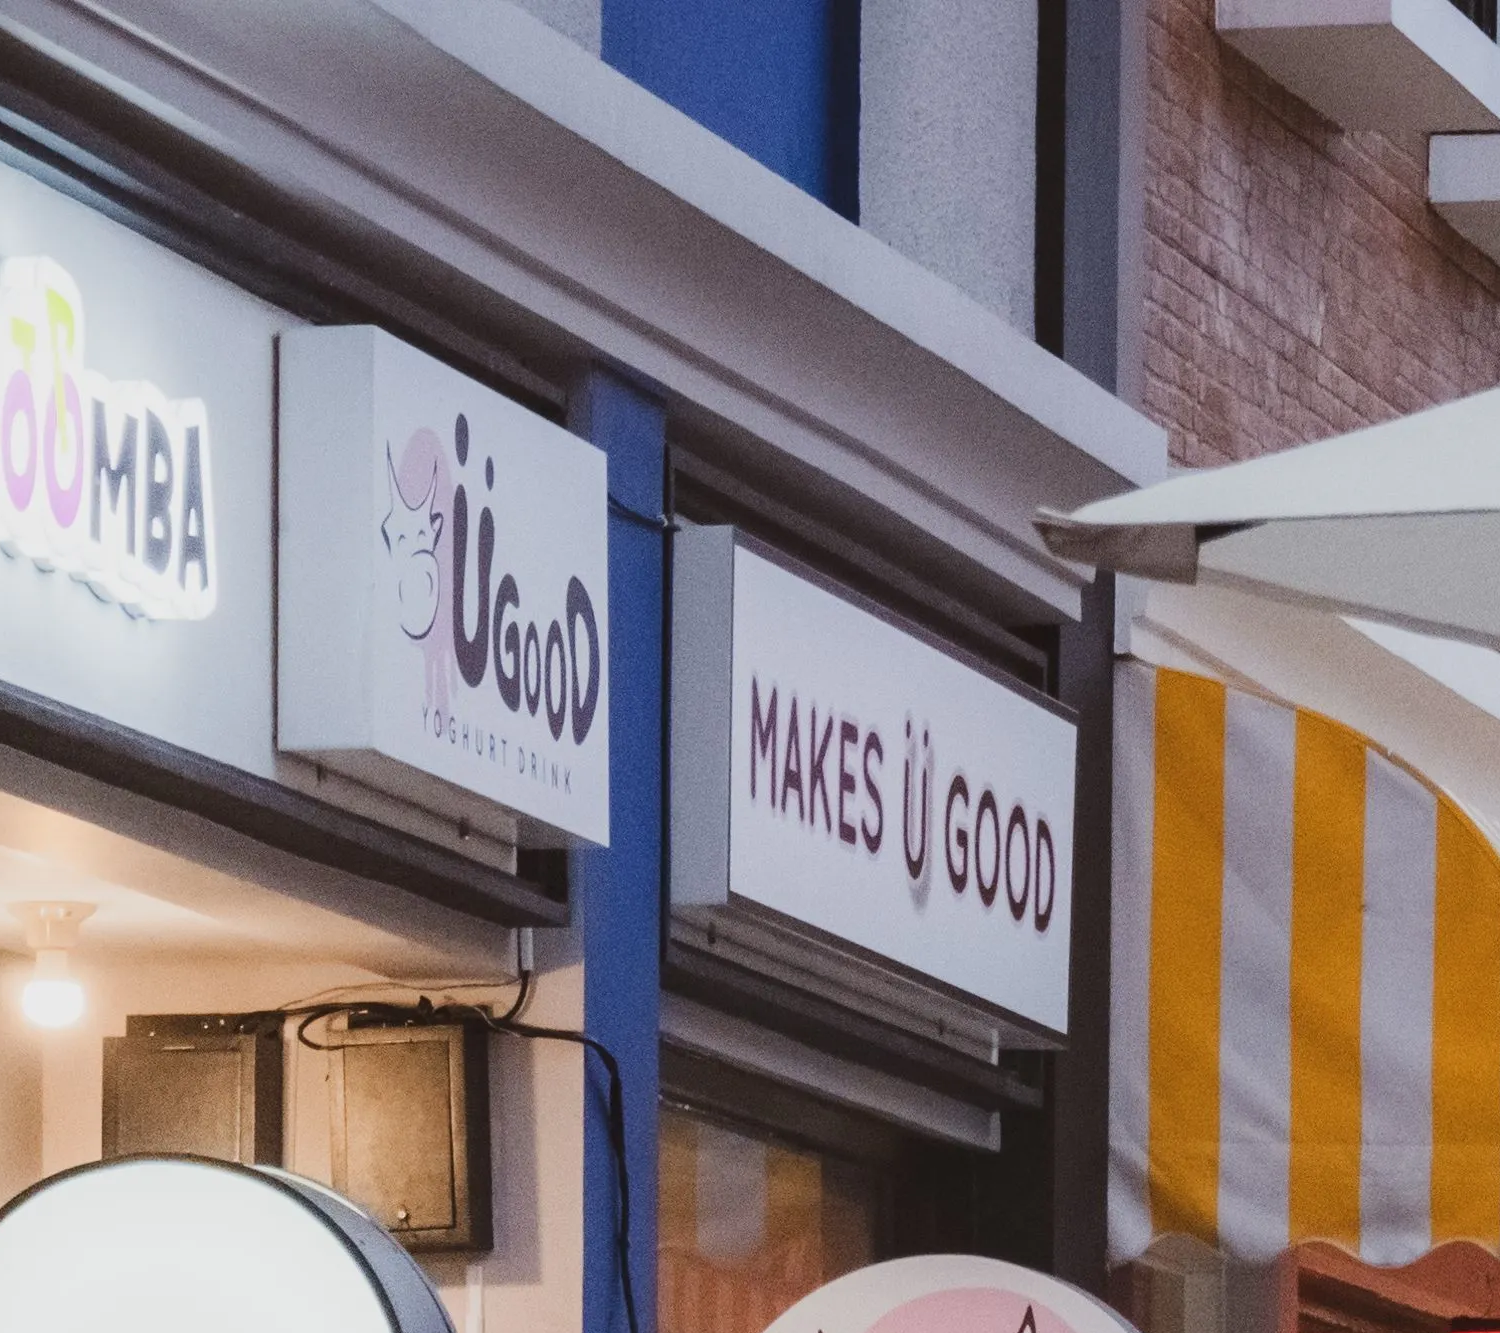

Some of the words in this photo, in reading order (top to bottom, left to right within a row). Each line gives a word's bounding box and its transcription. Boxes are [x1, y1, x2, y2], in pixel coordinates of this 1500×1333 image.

[421, 705, 509, 772] YOGHURT
[516, 748, 573, 795] DRINK
[749, 673, 884, 855] MAKES
[902, 716, 929, 882] Ü
[944, 773, 1056, 934] GOOD
